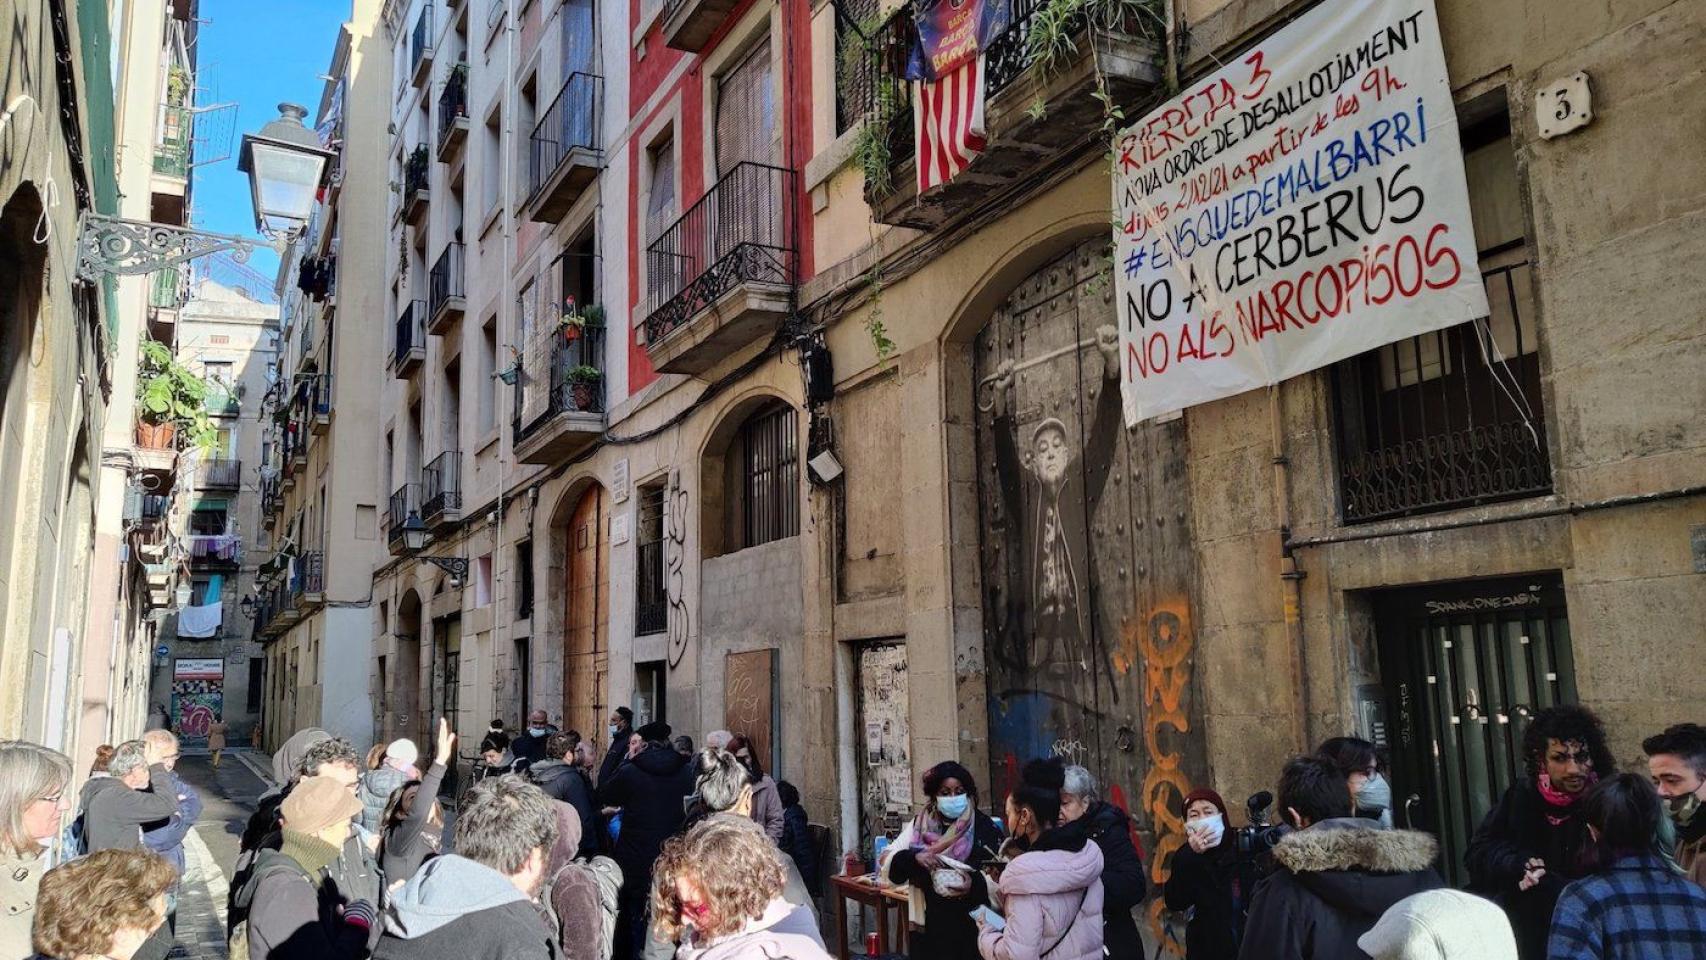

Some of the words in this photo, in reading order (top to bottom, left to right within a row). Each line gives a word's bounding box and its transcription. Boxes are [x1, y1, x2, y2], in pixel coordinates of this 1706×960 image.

[1119, 78, 1236, 175] RIERETA
[1242, 50, 1272, 100] 3
[1232, 164, 1246, 180] a
[1246, 126, 1309, 184] partir
[1310, 112, 1329, 138] de
[1333, 93, 1360, 121] les
[1555, 88, 1571, 120] 3
[1164, 136, 1213, 184] ORDRE
[1211, 117, 1239, 155] DE
[1127, 278, 1172, 332] NO
[1183, 263, 1208, 313] A
[1215, 163, 1425, 294] CERBERUS
[1127, 331, 1169, 384] NO
[1177, 310, 1234, 363] ALS
